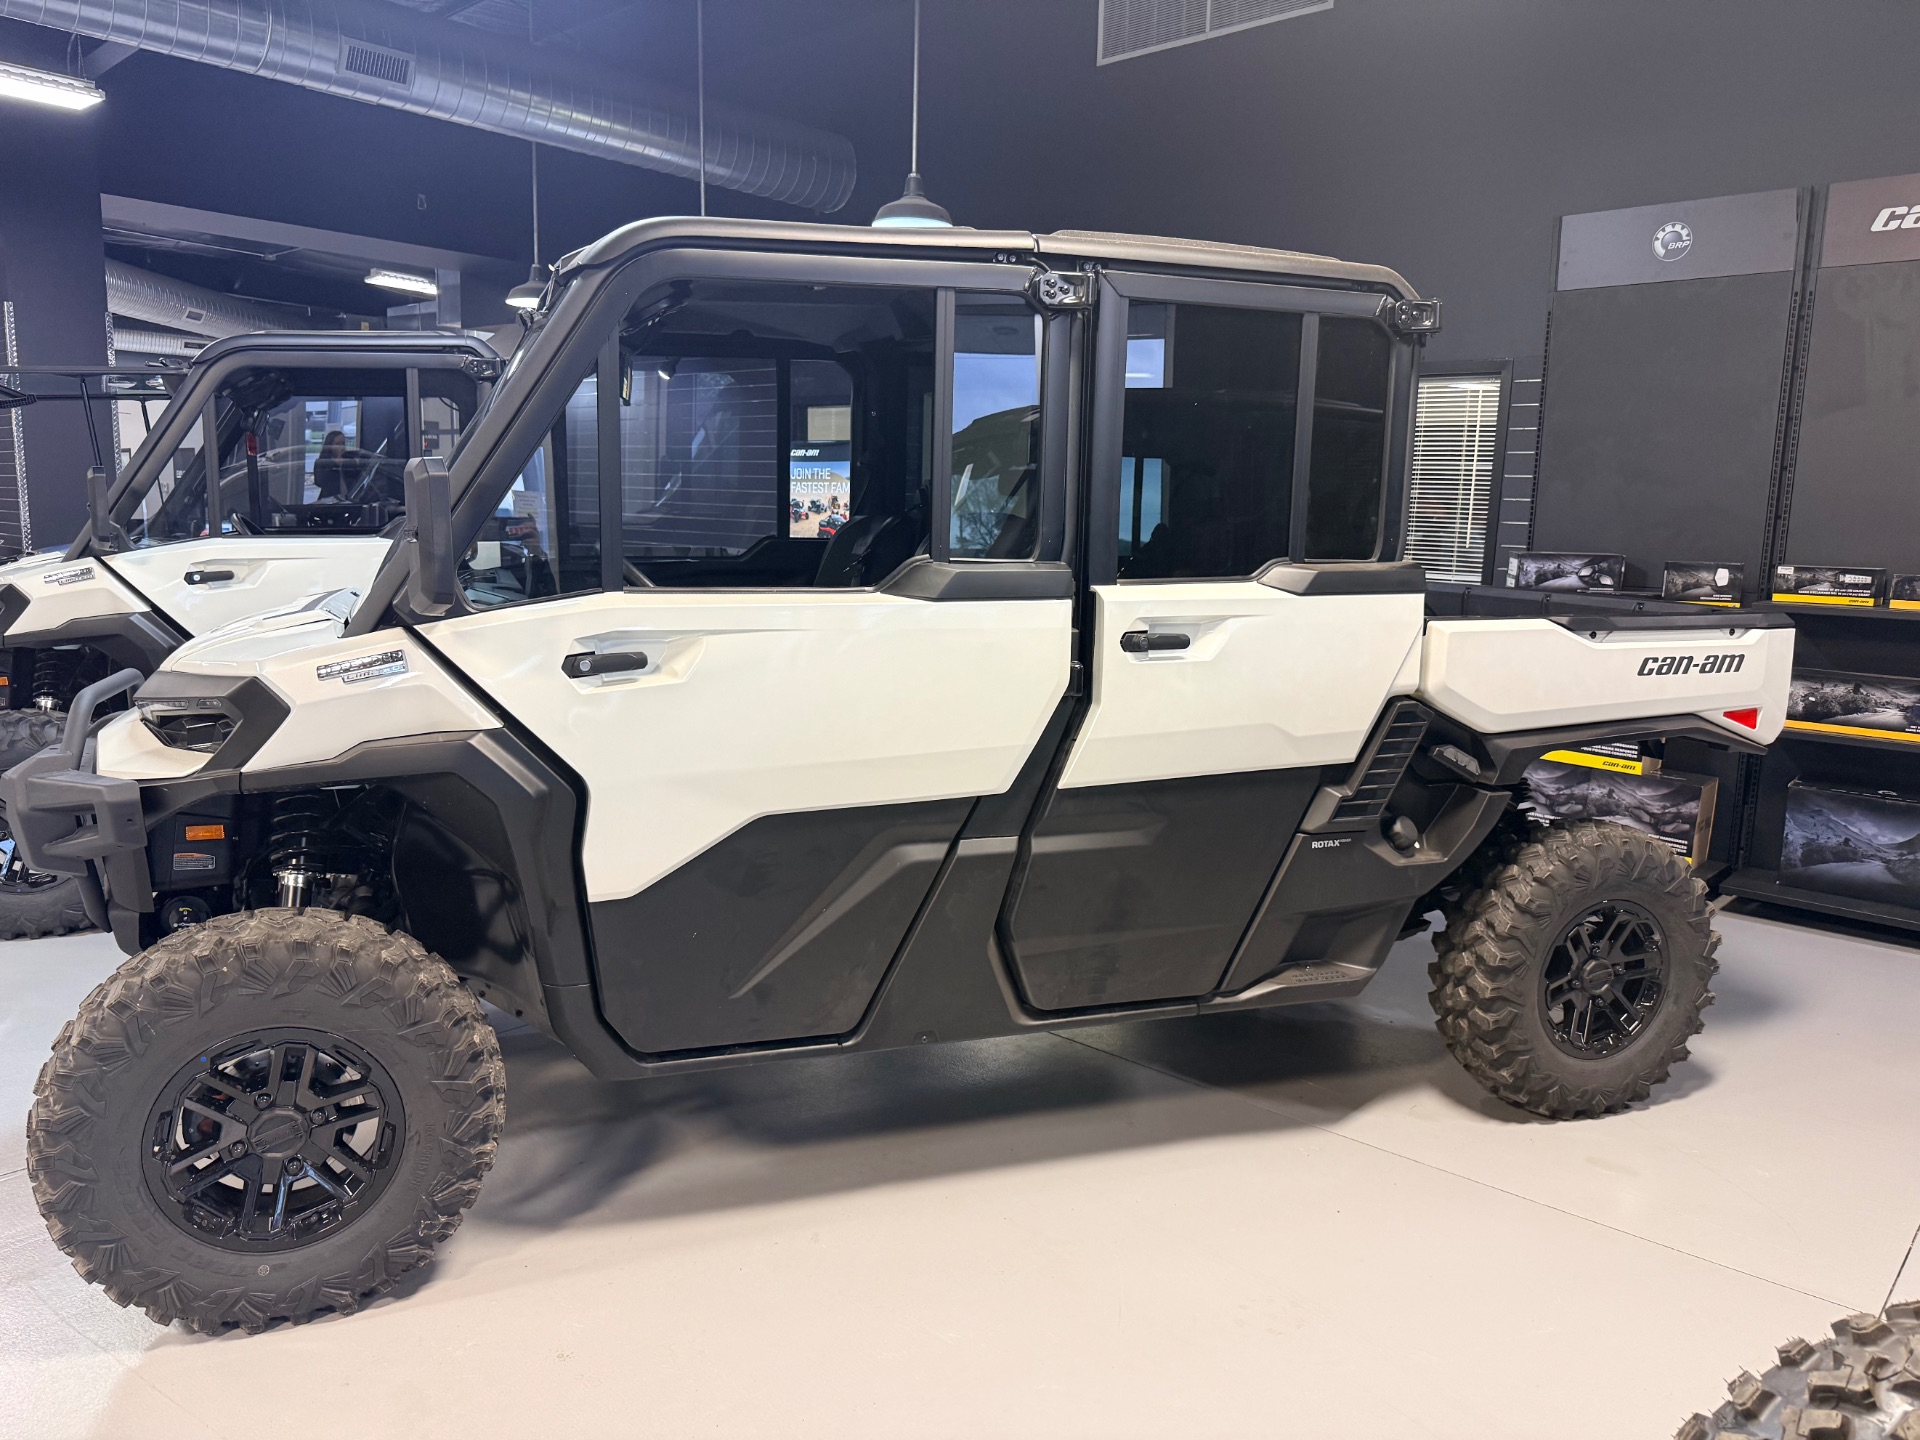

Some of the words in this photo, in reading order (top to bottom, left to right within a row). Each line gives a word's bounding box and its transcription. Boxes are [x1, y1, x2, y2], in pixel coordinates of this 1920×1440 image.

[1667, 240, 1690, 250] BRP
[791, 468, 811, 479] JOIN
[814, 468, 831, 479] THE
[790, 481, 829, 493] FASTEST
[1637, 653, 1745, 676] can-am
[1602, 760, 1636, 771] can-am
[1312, 840, 1340, 848] ROTAX
